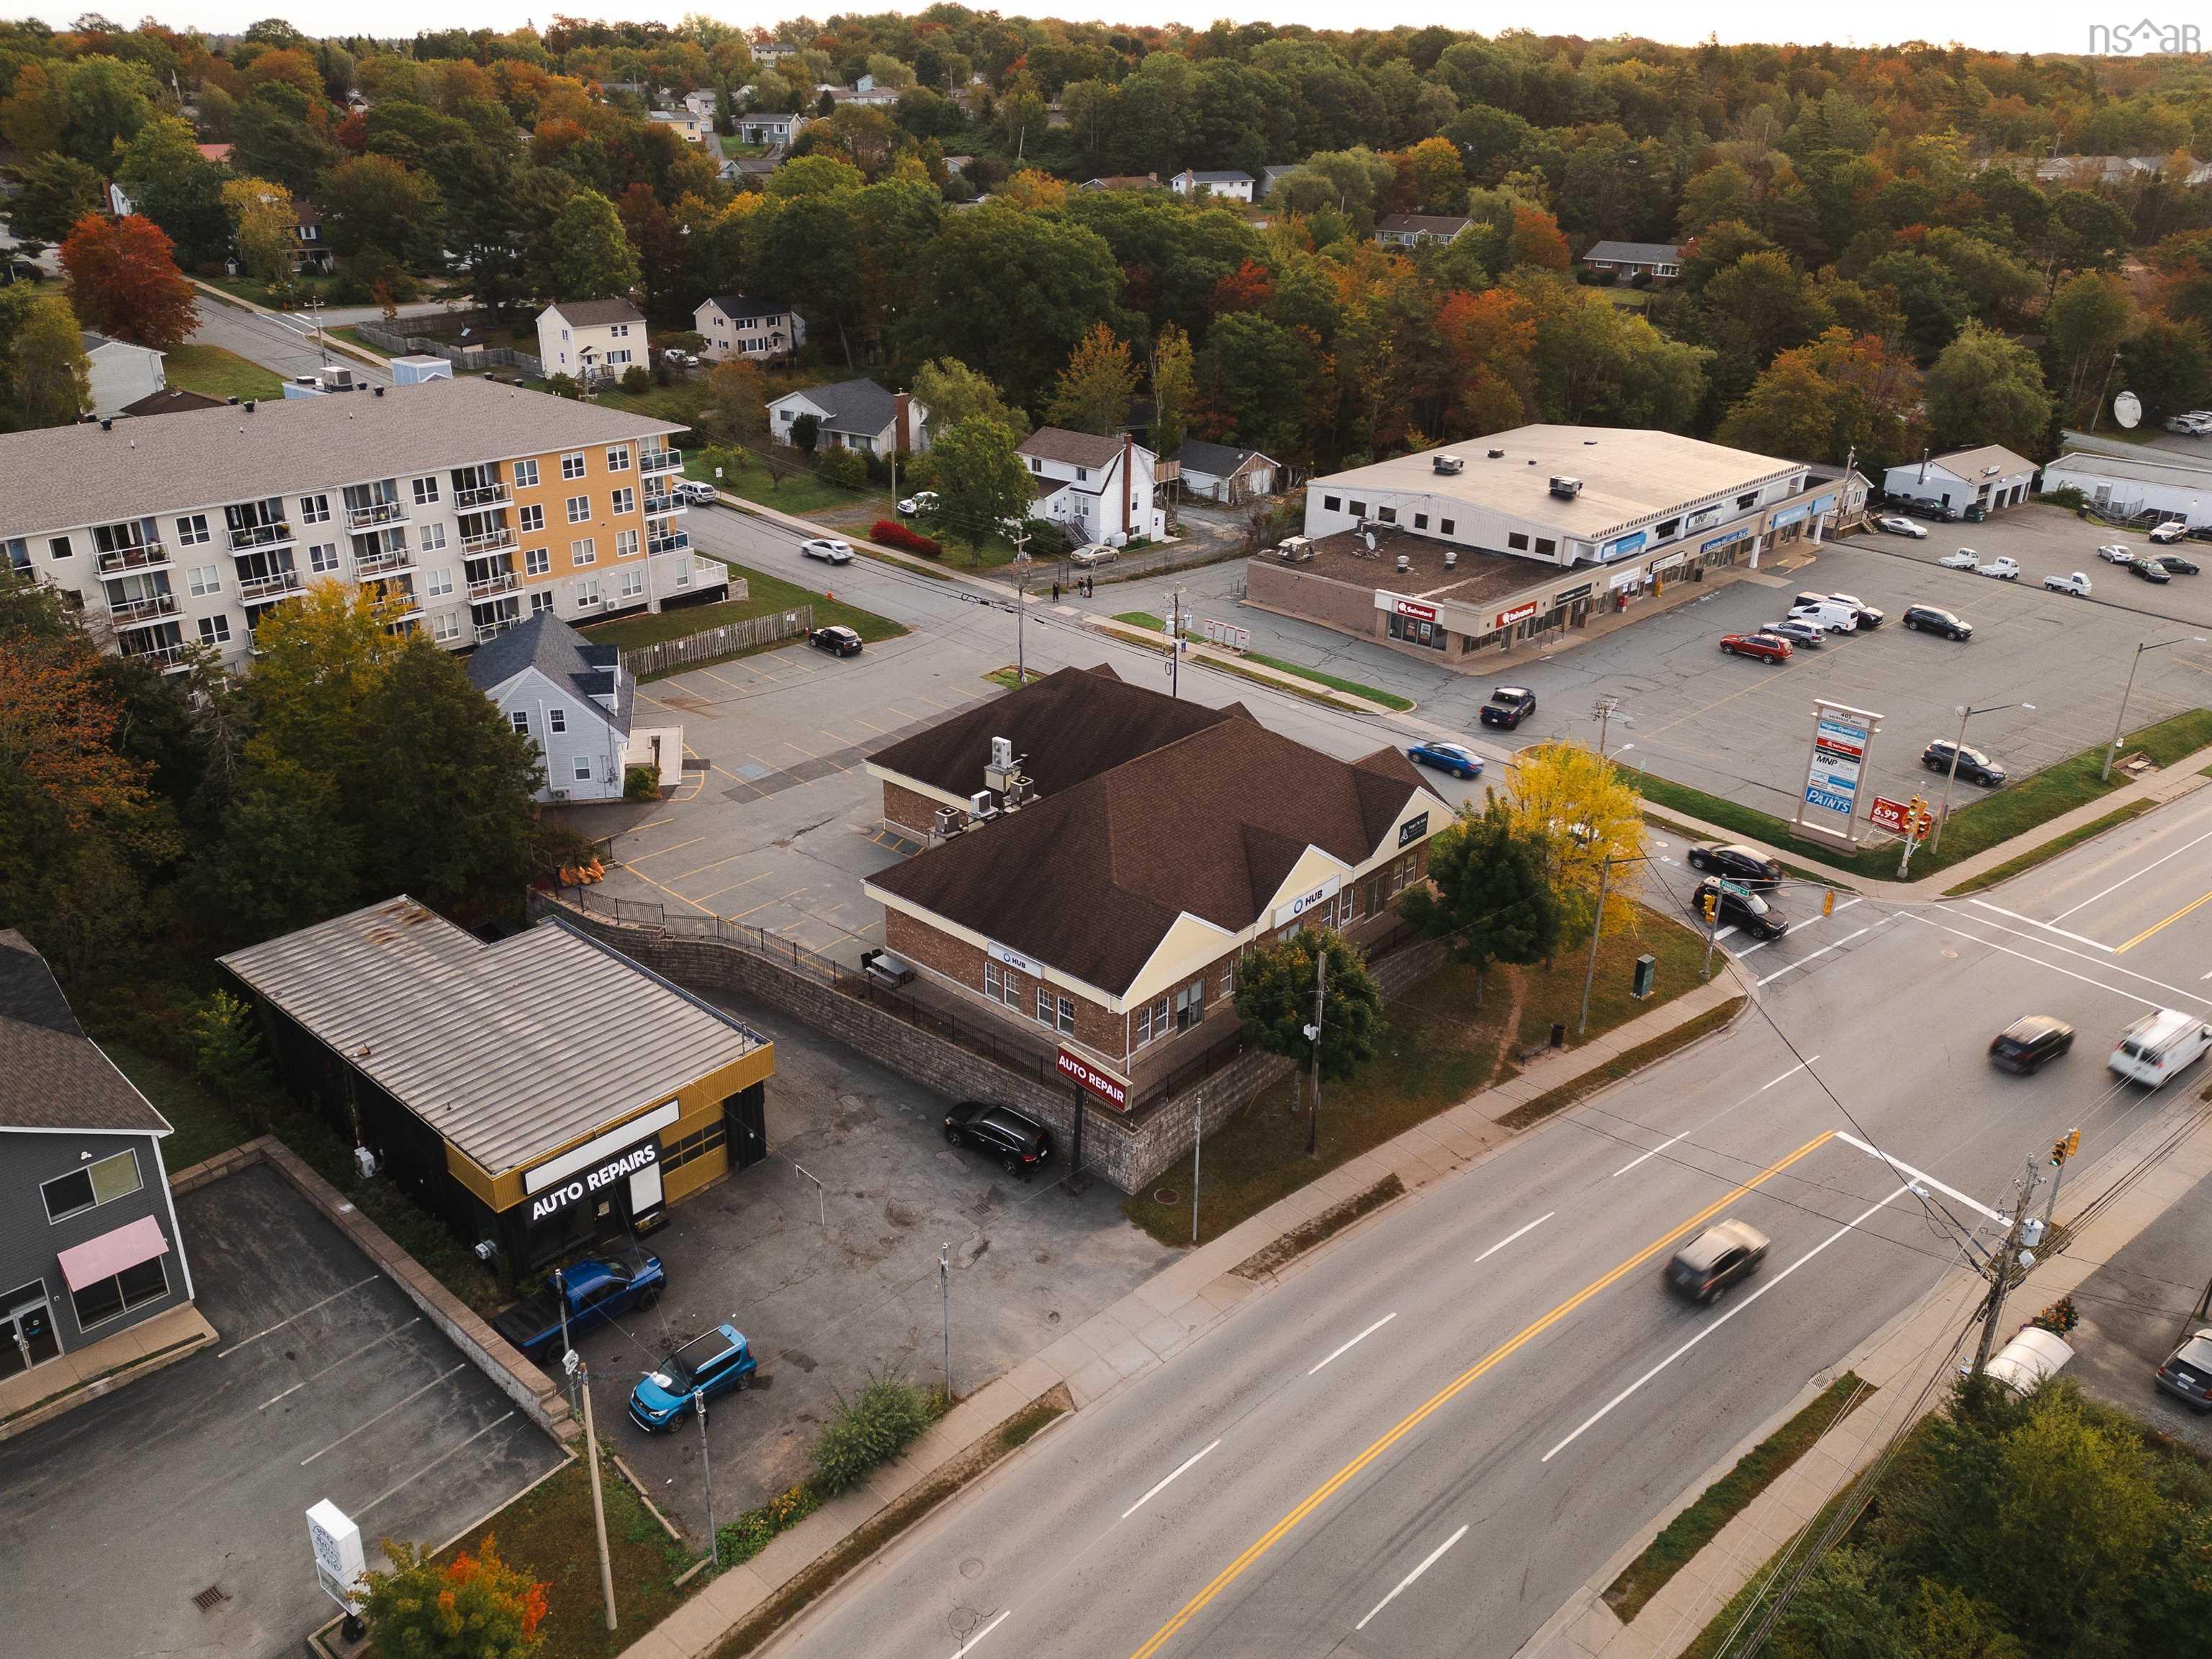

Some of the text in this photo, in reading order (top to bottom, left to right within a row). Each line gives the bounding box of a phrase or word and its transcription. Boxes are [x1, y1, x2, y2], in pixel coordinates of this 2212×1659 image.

[1693, 513, 1707, 526] MNP
[1816, 755, 1838, 766] MNP
[1807, 789, 1851, 812] PAINTS
[1874, 806, 1899, 821] 6.99
[1305, 889, 1323, 907] HUB
[1012, 957, 1026, 968] HUB
[1058, 1055, 1124, 1103] AUTO REPAIR
[533, 1144, 656, 1221] AUTO REPAIRS
